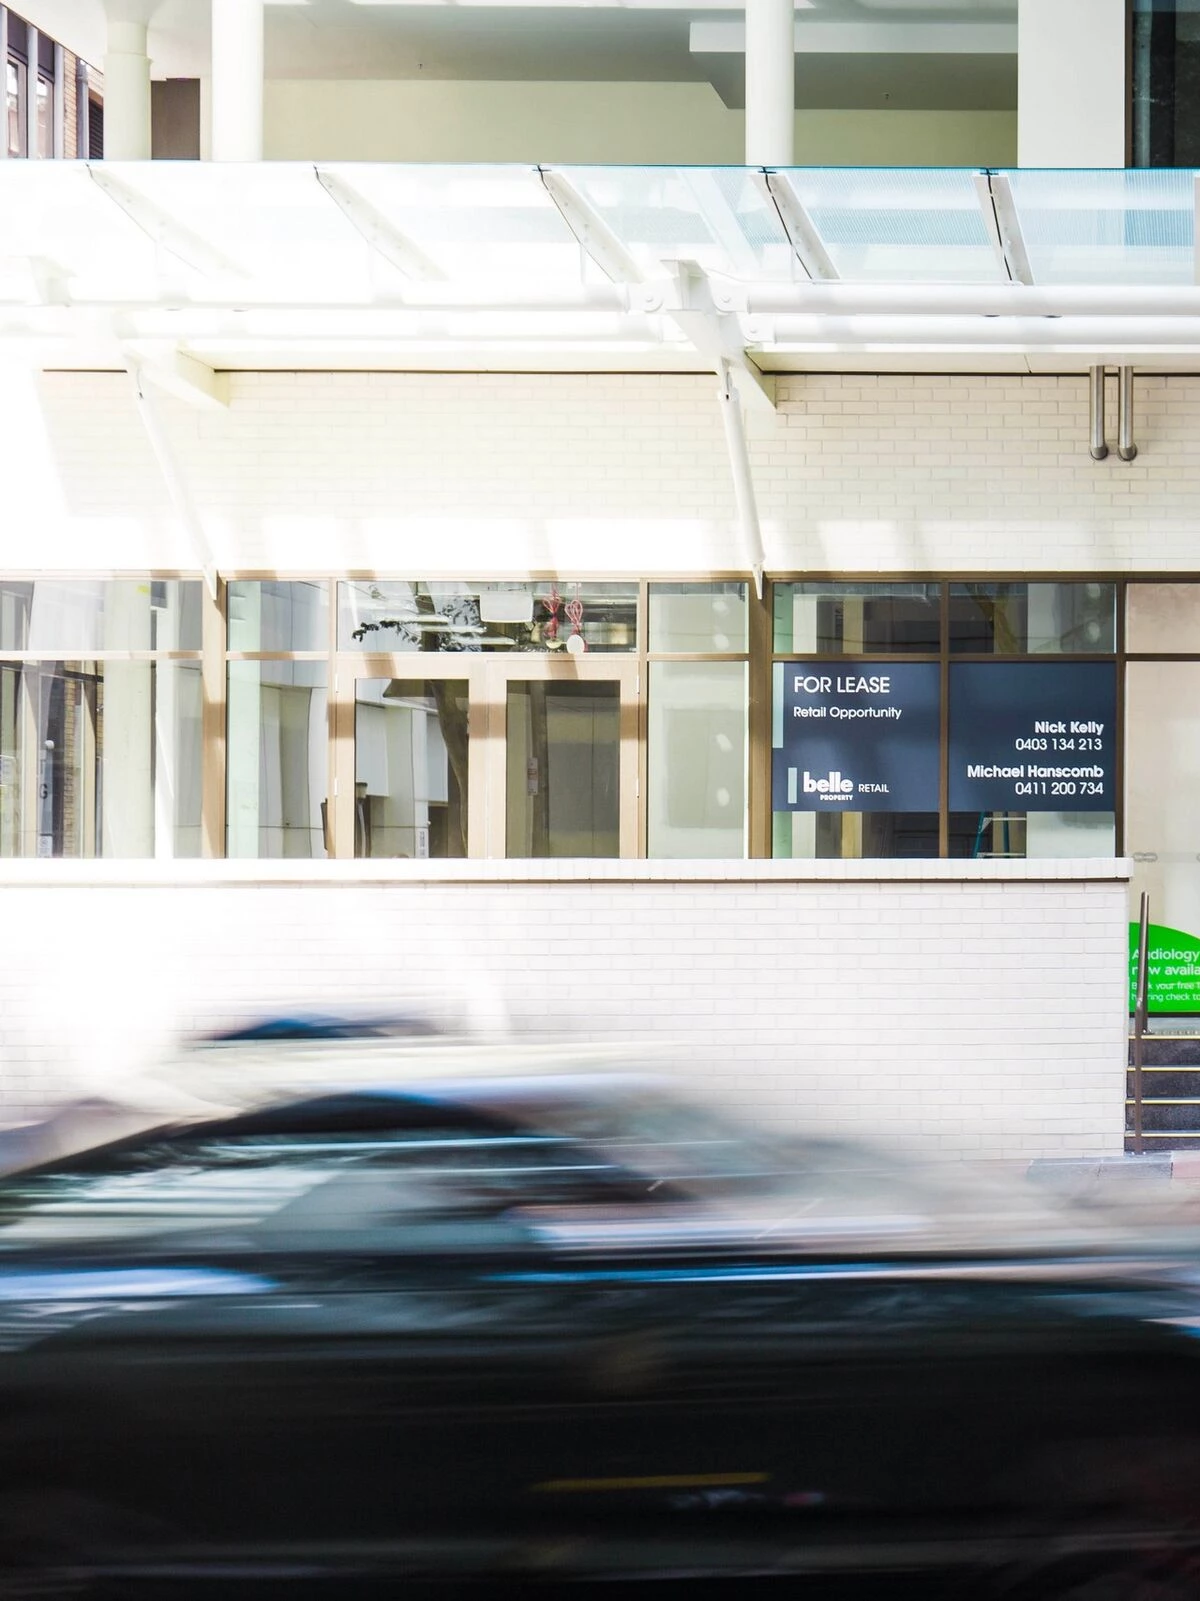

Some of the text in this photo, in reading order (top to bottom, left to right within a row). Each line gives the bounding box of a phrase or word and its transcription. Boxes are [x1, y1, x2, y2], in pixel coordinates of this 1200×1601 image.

[794, 676, 890, 693] FOR LEASE
[793, 706, 902, 719] Retail Opportunity
[1034, 721, 1104, 736] Nick Kelly
[1015, 738, 1103, 751] 0403 134 213
[967, 765, 1104, 778] Michael Hanscomb
[803, 771, 854, 793] belle
[858, 783, 889, 793] RETAIL
[1014, 781, 1104, 795] 0411 200 734
[1131, 948, 1200, 962] Adiology
[1131, 965, 1161, 976] nw
[1131, 981, 1153, 990] Bk
[1156, 983, 1175, 992] your
[1176, 981, 1195, 990] free
[1131, 992, 1164, 1002] hring
[1165, 992, 1190, 1001] check
